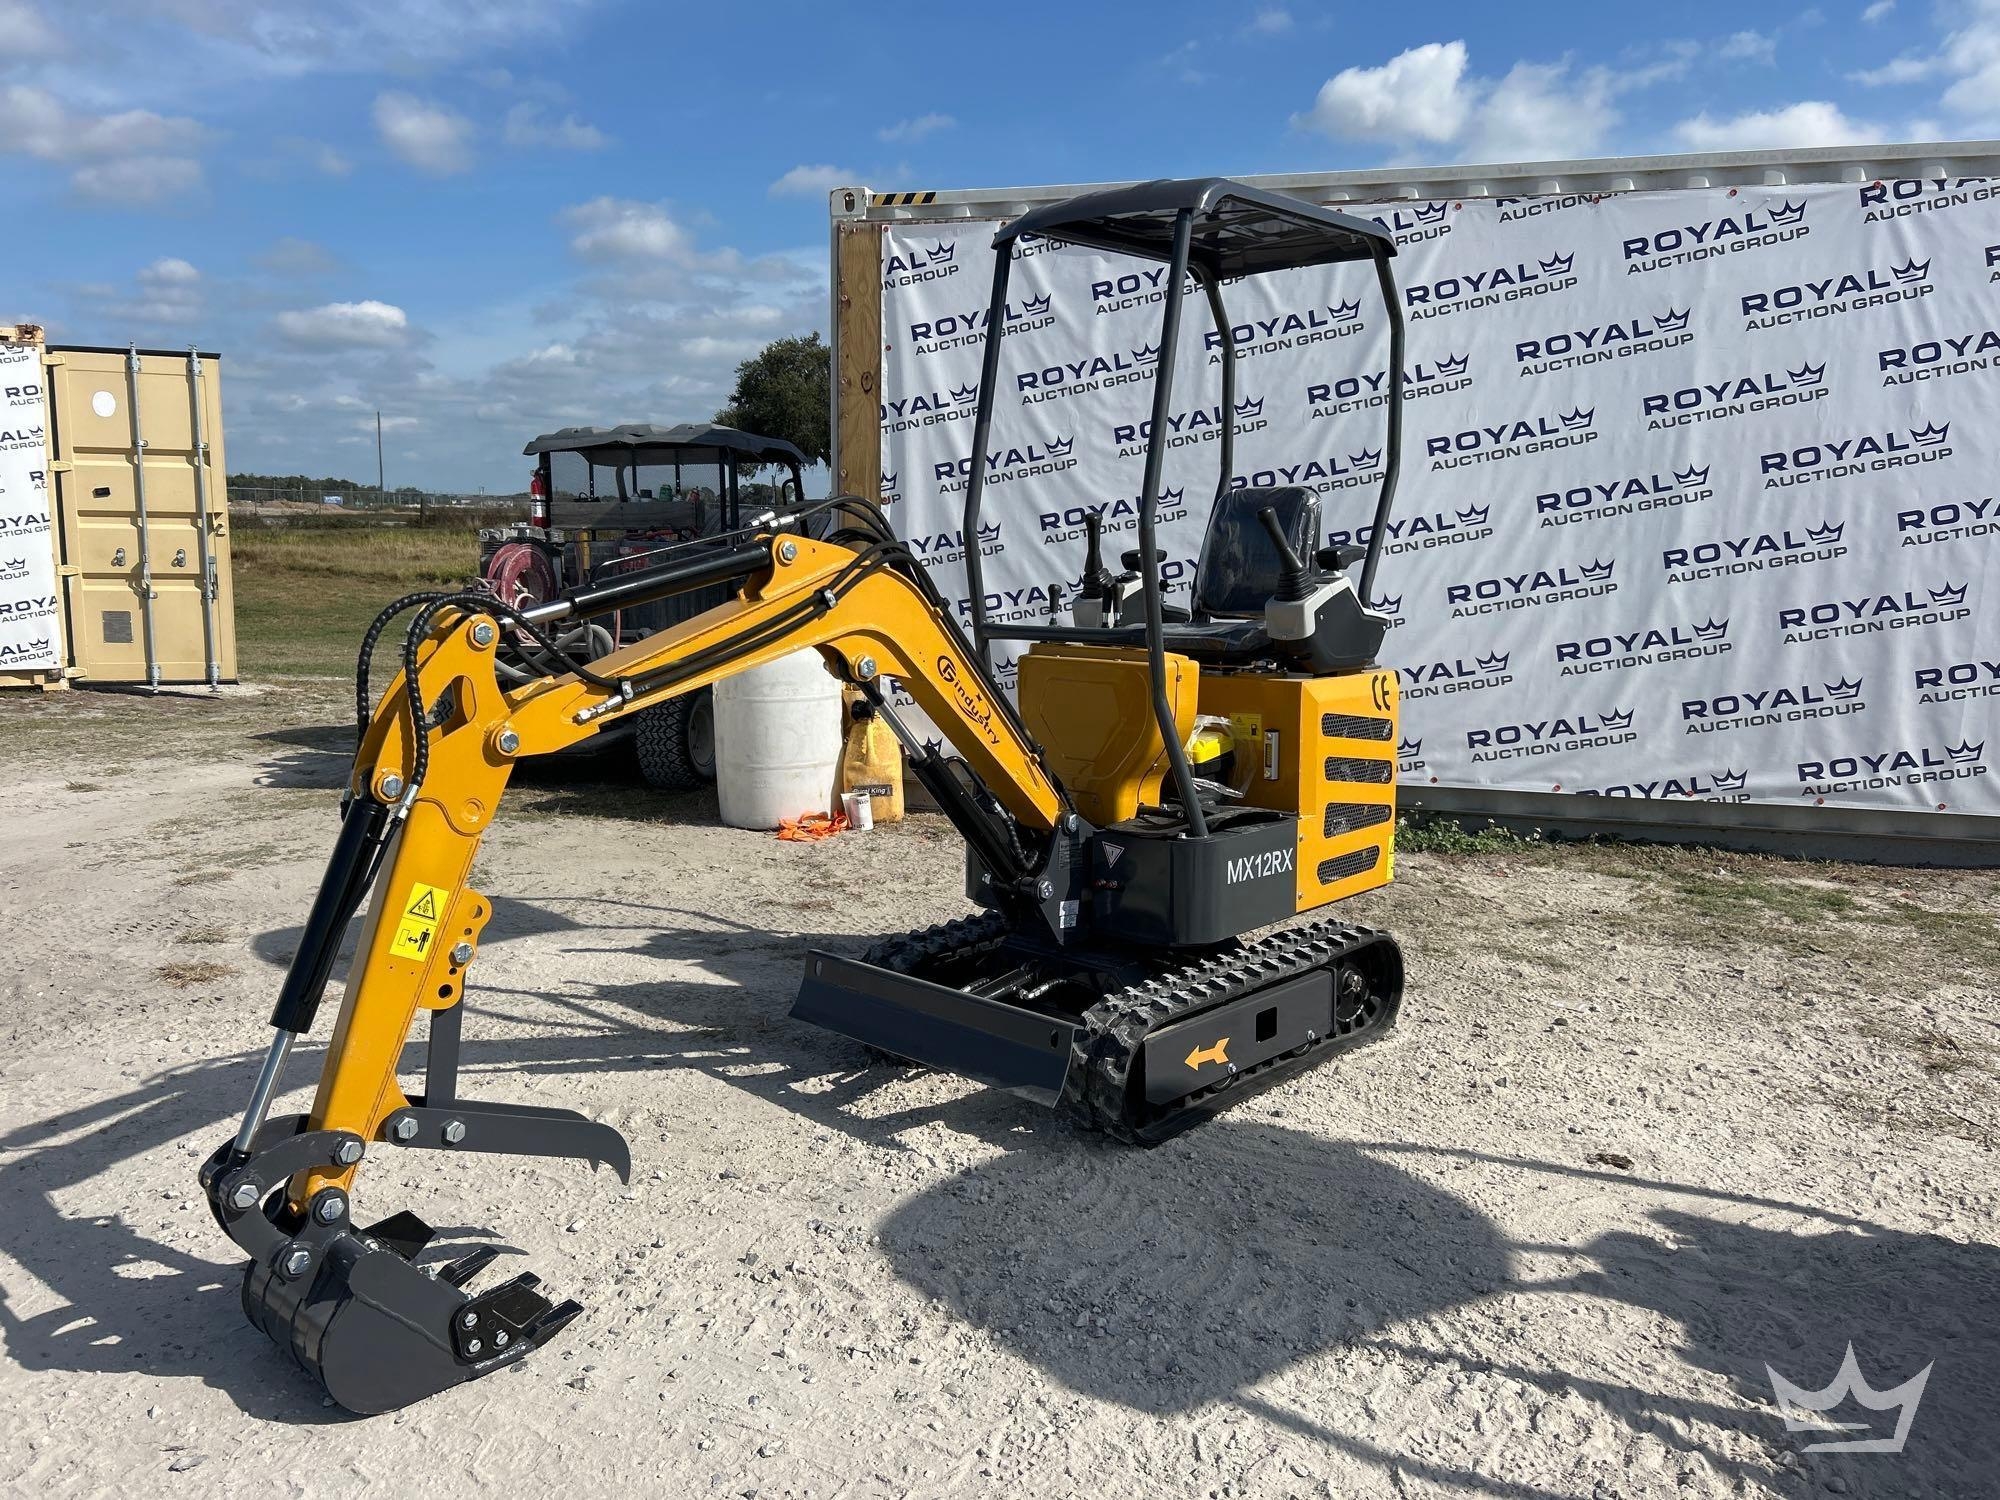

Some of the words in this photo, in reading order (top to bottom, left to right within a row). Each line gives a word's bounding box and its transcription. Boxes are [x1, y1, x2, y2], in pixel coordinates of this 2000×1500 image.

[1499, 194, 1593, 223] AUCTION
[1860, 179, 2000, 208] ROY
[1864, 192, 1968, 224] AUCTION
[1011, 239, 1075, 260] UCTION
[1395, 225, 1451, 246] ROUP
[1623, 213, 1768, 260] ROYAL
[1626, 245, 1726, 276] AUCTION
[1730, 226, 1811, 253] GROUP
[899, 264, 959, 287] GROUP
[1091, 267, 1190, 302] ROY
[1183, 275, 1247, 296] GRUP
[1405, 263, 1539, 307] ROYAL
[1409, 293, 1501, 322] AUCTION
[1504, 276, 1578, 302] GROUP
[1741, 269, 1891, 317] ROYAL
[1745, 301, 1847, 332] AUCTION
[1851, 284, 1935, 311] GROUP
[1203, 309, 1328, 351] ROYAL
[1208, 338, 1292, 366] ACTION
[1296, 322, 1365, 346] GROUP
[1515, 318, 1653, 363] ROYAL
[1519, 342, 1614, 378] AUCTION
[1617, 332, 1694, 358] GROUP
[1878, 330, 2000, 372] ROYA
[1017, 353, 1132, 392] ROYAL
[1402, 378, 1473, 401] GROUP
[1882, 358, 1987, 388] AUCTION
[880, 392, 951, 422] YAL
[1021, 380, 1099, 406] AUCTION
[1643, 373, 1787, 417] ROYAL
[1647, 403, 1745, 432] AUCTION
[1749, 387, 1829, 412] GROUP
[881, 418, 920, 435] TION
[1426, 416, 1560, 457] ROYAL
[10, 440, 45, 450] GROU
[1118, 433, 1199, 459] AUCION
[1430, 445, 1521, 472] AUCTION
[1525, 431, 1598, 454] GROUP
[1760, 432, 1910, 474] ROYAL
[939, 471, 1014, 494] AUCION
[1016, 458, 1078, 479] GROUP
[1317, 471, 1386, 493] GROUP
[1764, 461, 1866, 490] AUCTION
[1870, 447, 1954, 472] GROUP
[1536, 474, 1674, 514] ROYAL
[1540, 502, 1634, 529] AUCTION
[1637, 489, 1713, 512] GROUP
[0, 512, 51, 530] YAL
[1043, 522, 1121, 545] AUCTON
[1124, 509, 1188, 530] GOUP
[1897, 498, 2000, 532] ROY
[0, 528, 32, 538] TION
[898, 531, 966, 554] YAL
[1423, 527, 1493, 549] GROUP
[1662, 530, 1806, 570] ROYAL
[1901, 522, 2000, 548] AUCTION
[947, 543, 1005, 563] GRUP
[1666, 559, 1764, 585] AUCTION
[1767, 546, 1848, 569] GROUP
[1447, 568, 1579, 605] ROYAL
[1451, 594, 1542, 620] AUCTION
[1545, 582, 1619, 604] GROUP
[0, 596, 57, 614] ROYA
[2, 609, 55, 623] AUCTION
[962, 608, 1036, 630] ACTION
[1779, 591, 1928, 630] ROYAL
[1783, 620, 1885, 645] AUCTION
[1889, 607, 1972, 631] GROUP
[11, 651, 53, 664] GROUP
[1555, 626, 1694, 662] ROYAL
[1560, 653, 1653, 677] AUCTION
[1656, 642, 1733, 662] GROUP
[1402, 659, 1476, 684] YAL
[1443, 674, 1514, 695] GROUP
[1915, 661, 2000, 690] ROY
[1372, 675, 1391, 712] CE
[1681, 685, 1825, 720] ROYAL
[1919, 684, 2000, 705] AUCTIO
[1467, 716, 1600, 749] ROYAL
[1685, 712, 1783, 735] AUCTION
[1786, 702, 1867, 723] GROUP
[1471, 741, 1561, 763] AUCTION
[1566, 732, 1638, 752] GROUP
[1797, 748, 1945, 782] ROYAL
[1801, 775, 1903, 796] AUCTION
[1906, 766, 1987, 787] GROUP
[1227, 848, 1294, 885] MX12RX
